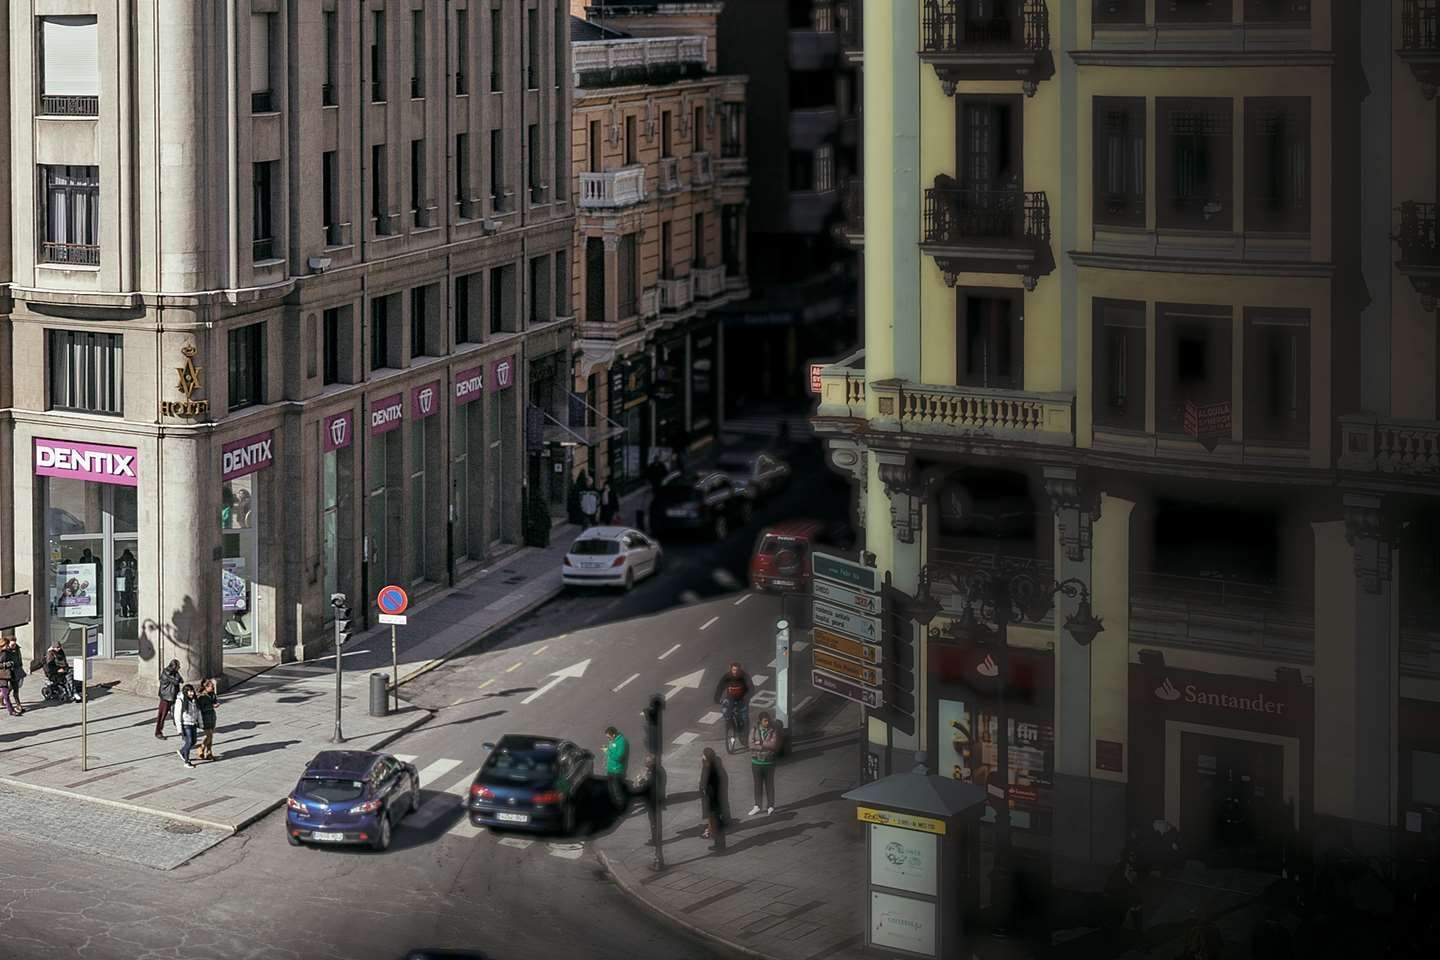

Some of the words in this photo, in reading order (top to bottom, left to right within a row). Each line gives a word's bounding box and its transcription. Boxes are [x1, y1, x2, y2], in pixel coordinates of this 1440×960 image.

[455, 375, 483, 397] DENTIX
[371, 403, 402, 427] DENTIX
[36, 444, 135, 478] DENTIX
[223, 440, 272, 474] DENTIX
[1184, 685, 1284, 714] Santander
